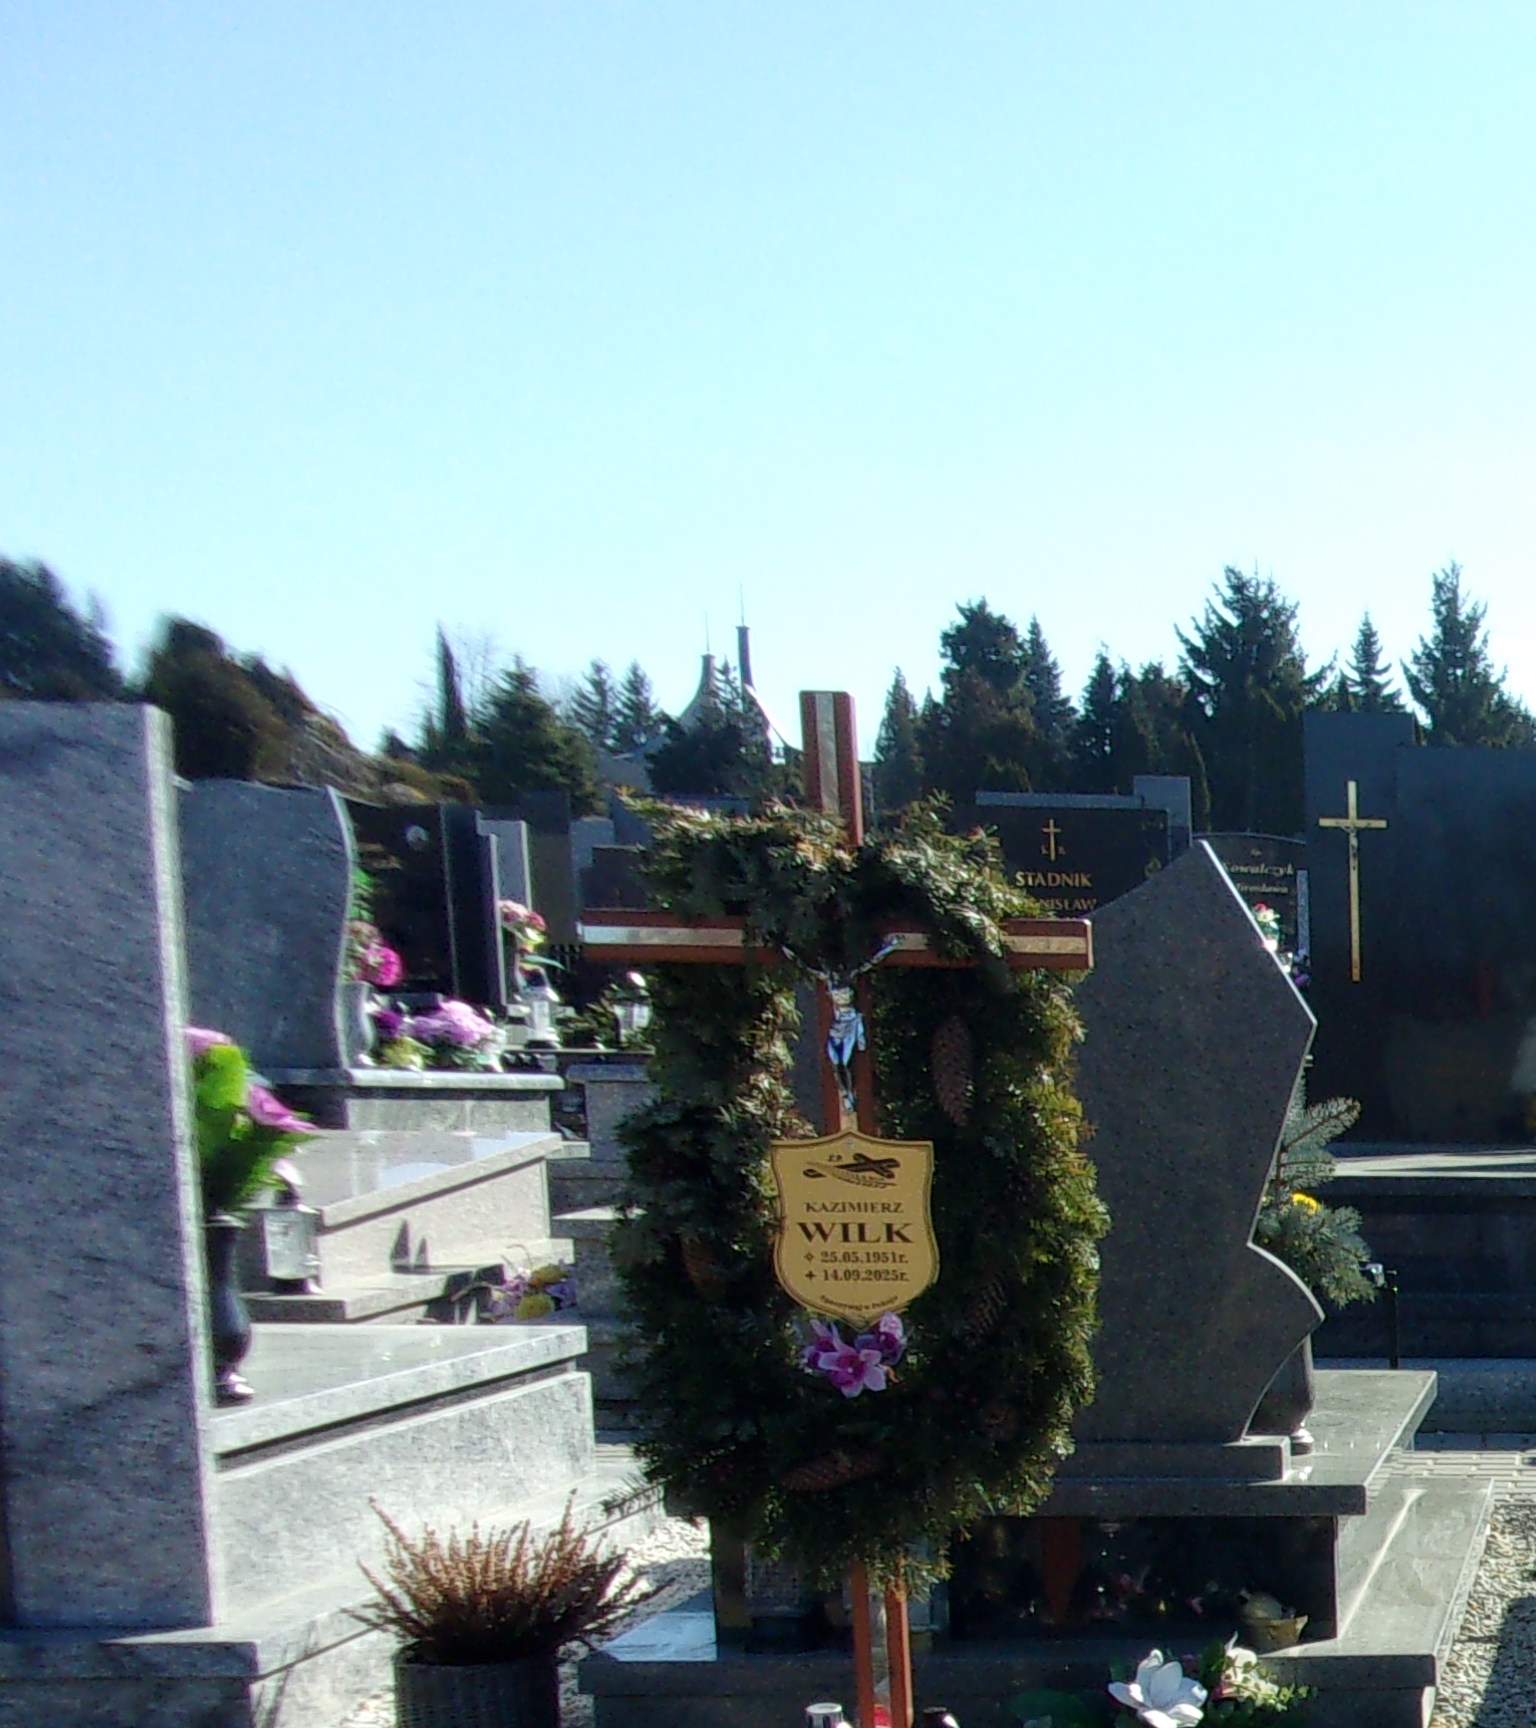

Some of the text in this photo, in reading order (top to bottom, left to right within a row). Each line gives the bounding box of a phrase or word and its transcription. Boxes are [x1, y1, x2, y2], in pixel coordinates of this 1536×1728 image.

[1015, 870, 1093, 888] STADNIK
[804, 1201, 904, 1214] KAZIMIERZ
[797, 1221, 914, 1244] WILK
